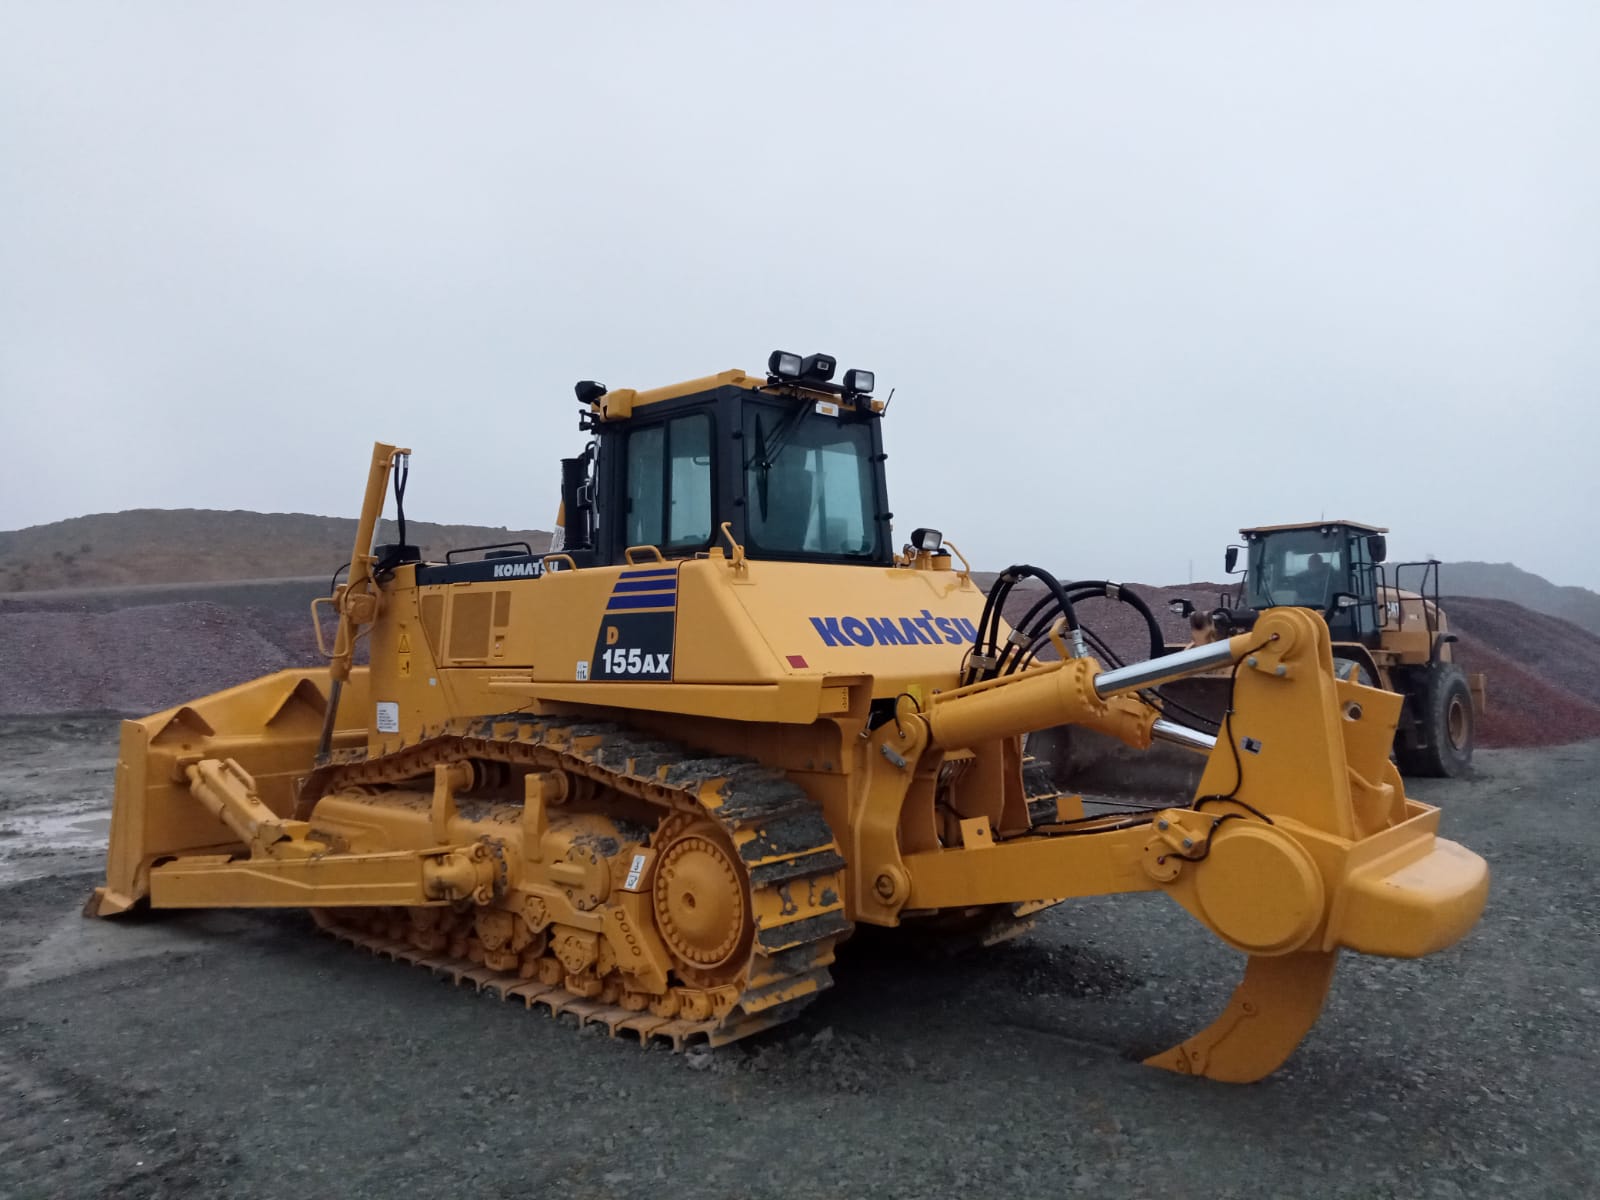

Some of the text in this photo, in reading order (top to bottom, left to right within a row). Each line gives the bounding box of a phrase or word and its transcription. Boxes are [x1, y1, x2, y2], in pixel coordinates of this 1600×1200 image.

[606, 626, 619, 645] D
[808, 609, 978, 647] KOMATSU
[602, 648, 670, 674] 155AX
